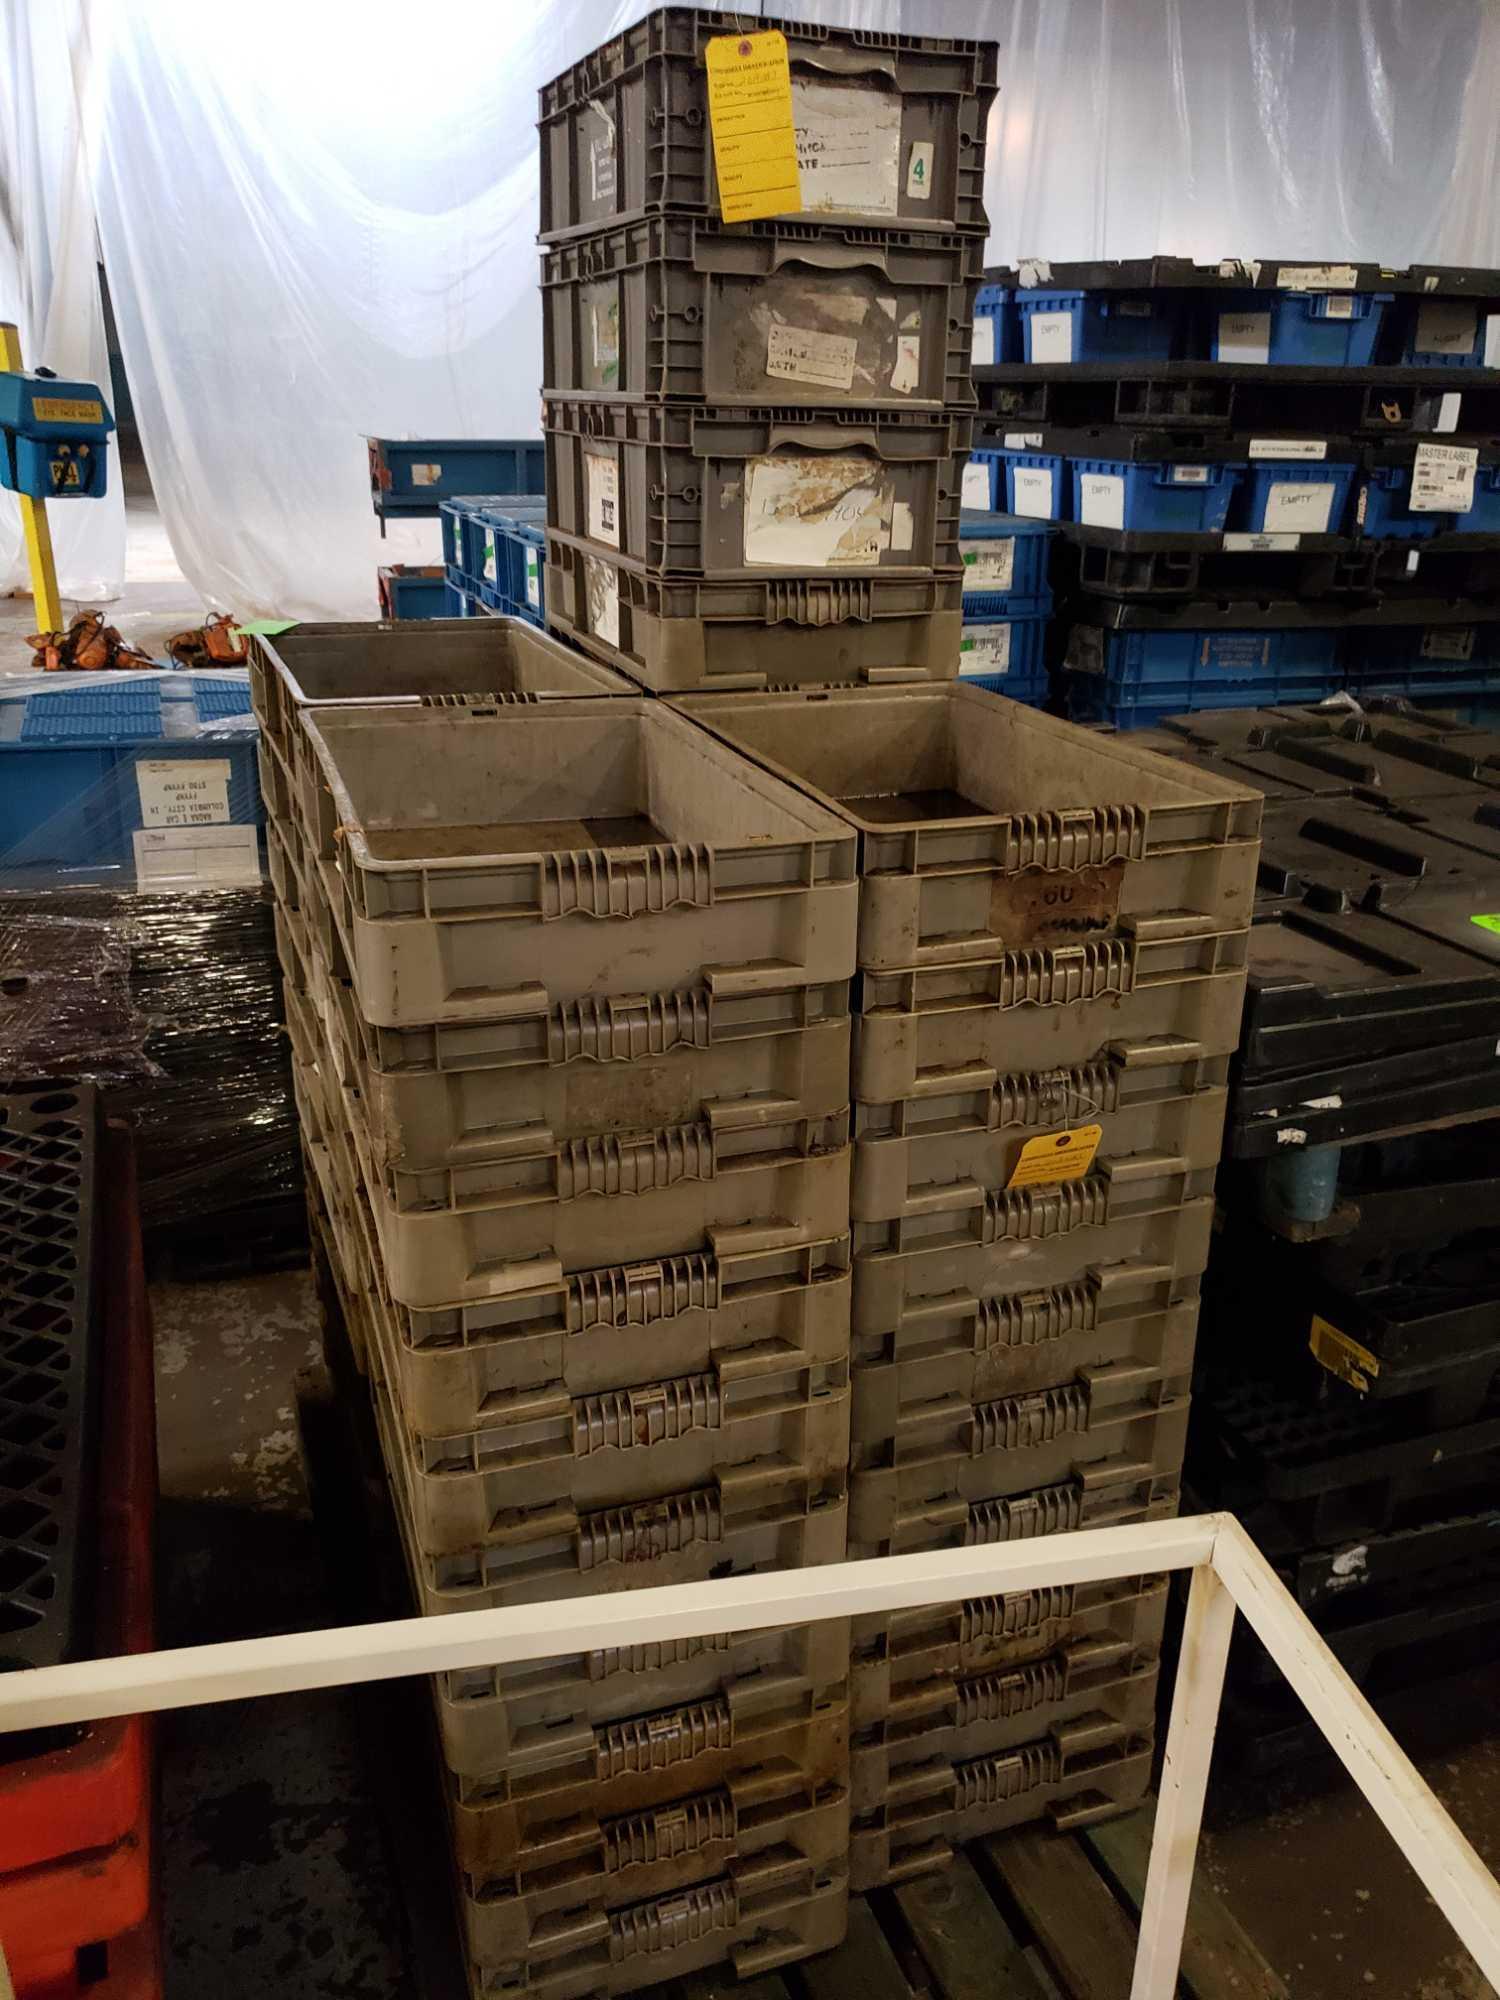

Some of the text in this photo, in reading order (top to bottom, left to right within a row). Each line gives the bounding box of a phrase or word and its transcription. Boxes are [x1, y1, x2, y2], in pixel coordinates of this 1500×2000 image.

[912, 157, 925, 179] 4
[1417, 447, 1448, 460] MASTER
[1279, 494, 1312, 506] EMPTY
